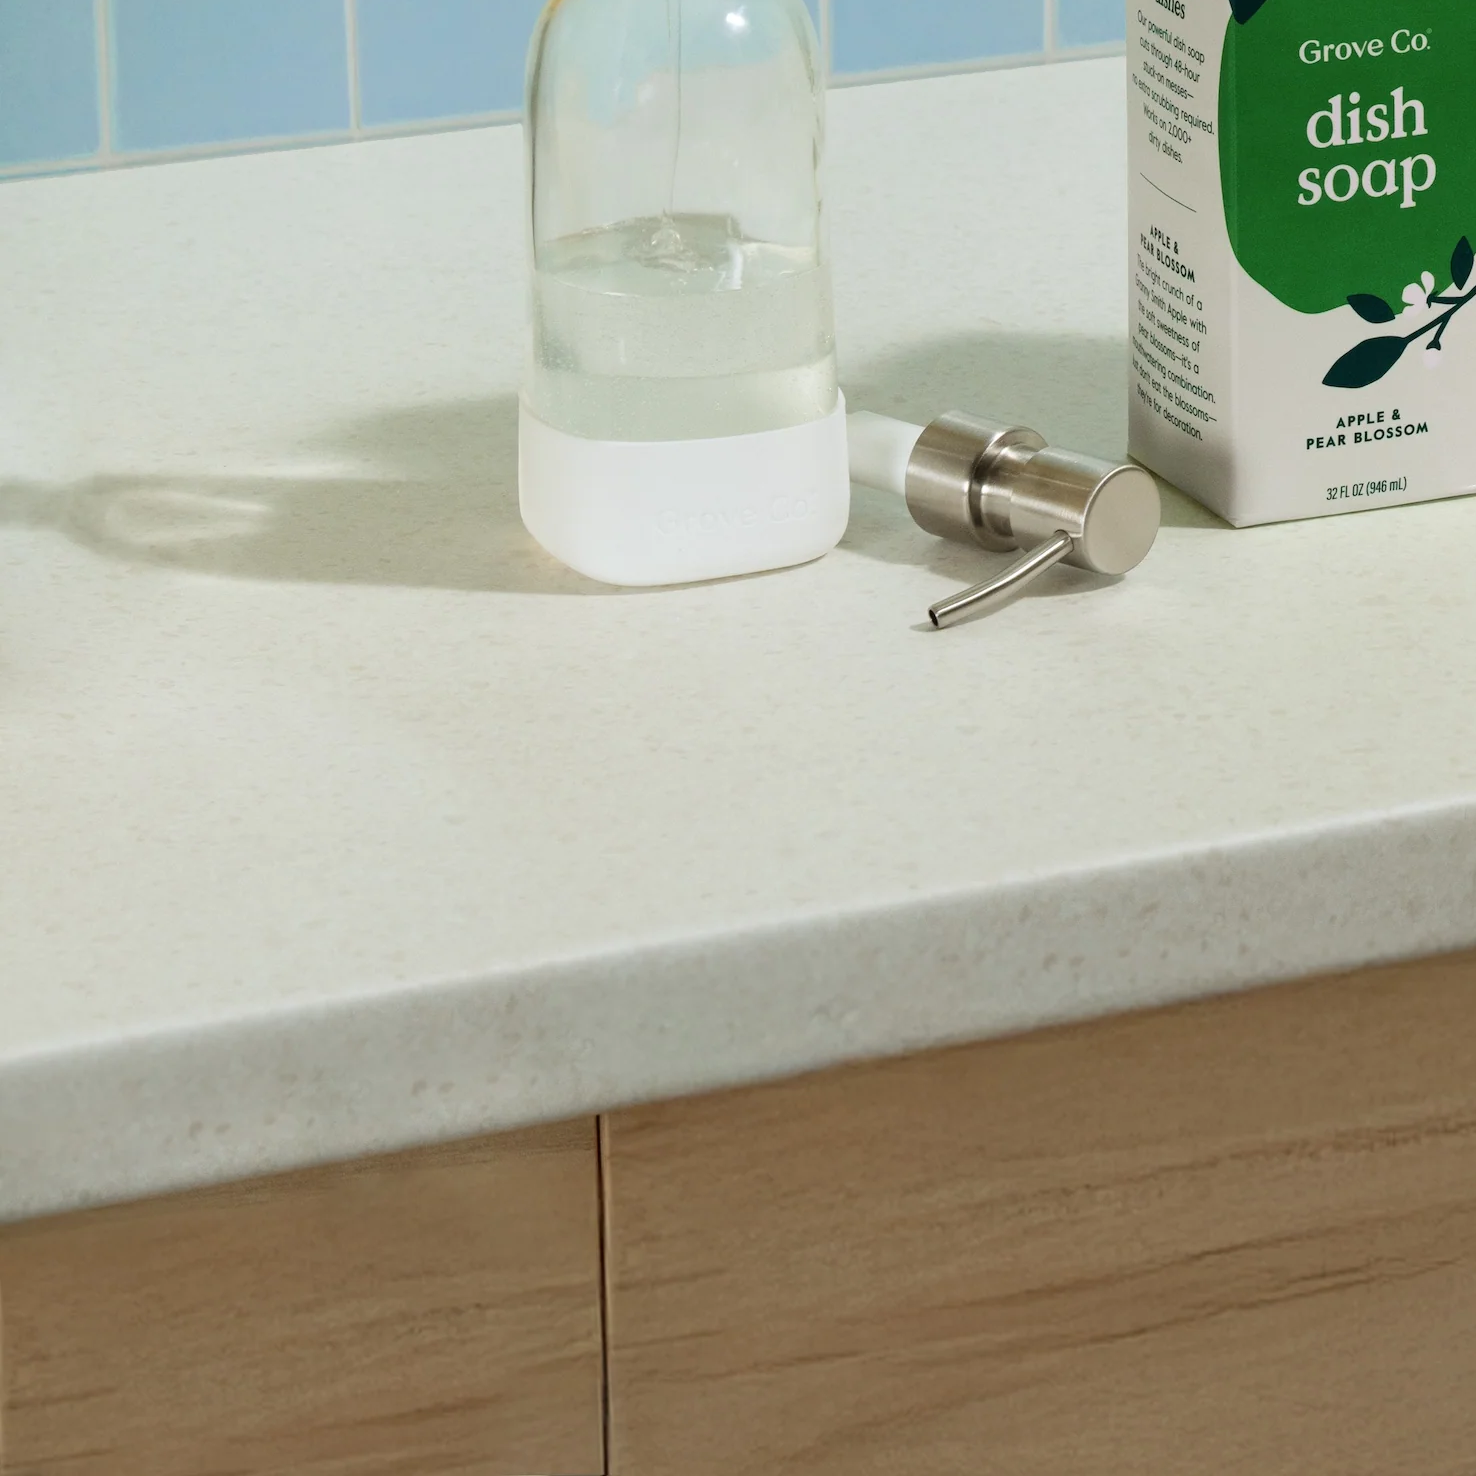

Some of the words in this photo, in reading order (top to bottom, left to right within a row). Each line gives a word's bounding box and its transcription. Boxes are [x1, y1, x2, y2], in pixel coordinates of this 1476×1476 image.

[1137, 9, 1147, 27] Our
[1148, 20, 1173, 44] powerful
[1172, 35, 1187, 54] dish
[1187, 45, 1205, 66] soap
[1299, 38, 1384, 64] Grove
[1139, 36, 1151, 52] cuts
[1150, 43, 1173, 69] through
[1173, 59, 1200, 84] 48-hour
[1142, 59, 1165, 84] stuck-on
[1138, 80, 1151, 97] extra
[1151, 90, 1179, 121] scrubbing
[1180, 110, 1215, 135] required.
[1143, 102, 1159, 124] Works
[1158, 117, 1167, 131] on
[1306, 85, 1429, 149] dish
[1148, 131, 1161, 153] dirty
[1161, 140, 1183, 164] dishes.
[1297, 153, 1437, 209] soap
[1149, 224, 1171, 249] APPLE
[1173, 240, 1179, 255] &
[1140, 232, 1155, 256] PEAR
[1156, 247, 1196, 283] BLOSSOM
[1151, 289, 1167, 312] Smith
[1167, 303, 1188, 324] Apple
[1189, 318, 1207, 335] with
[1162, 280, 1184, 302] crunch
[1185, 294, 1195, 307] of
[1196, 300, 1203, 311] a
[1156, 319, 1190, 348] sweetness
[1191, 340, 1200, 353] of
[1193, 363, 1199, 375] a
[1151, 378, 1162, 394] eat
[1162, 385, 1174, 402] the
[1167, 369, 1216, 404] combination.
[1153, 397, 1162, 414] for
[1163, 406, 1203, 441] decoration.
[1336, 410, 1385, 429] APPLE
[1391, 408, 1401, 421] &
[1306, 434, 1346, 450] PEAR
[1354, 421, 1429, 444] BLOSSOM
[1326, 486, 1338, 501] 32
[1339, 485, 1350, 499] FL
[1352, 482, 1364, 497] OZ
[1366, 479, 1387, 497] (946
[1389, 476, 1407, 492] mL)
